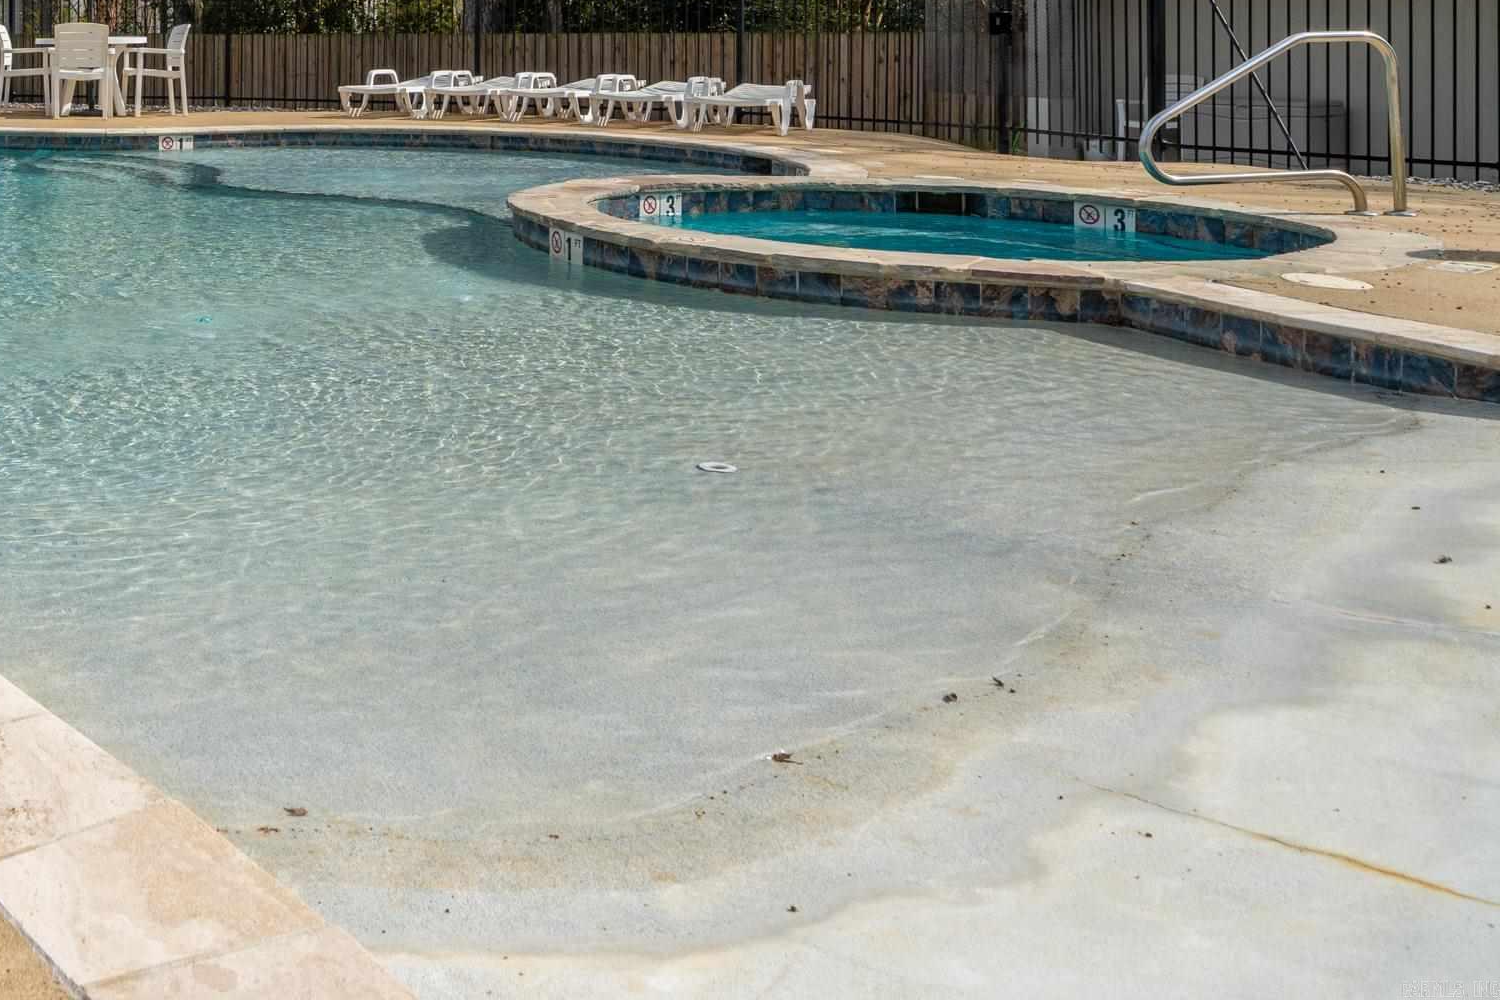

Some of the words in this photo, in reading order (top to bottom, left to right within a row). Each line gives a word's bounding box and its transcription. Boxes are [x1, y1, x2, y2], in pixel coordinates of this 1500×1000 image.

[666, 195, 675, 214] 3
[1114, 208, 1126, 231] 3
[565, 237, 572, 261] 1
